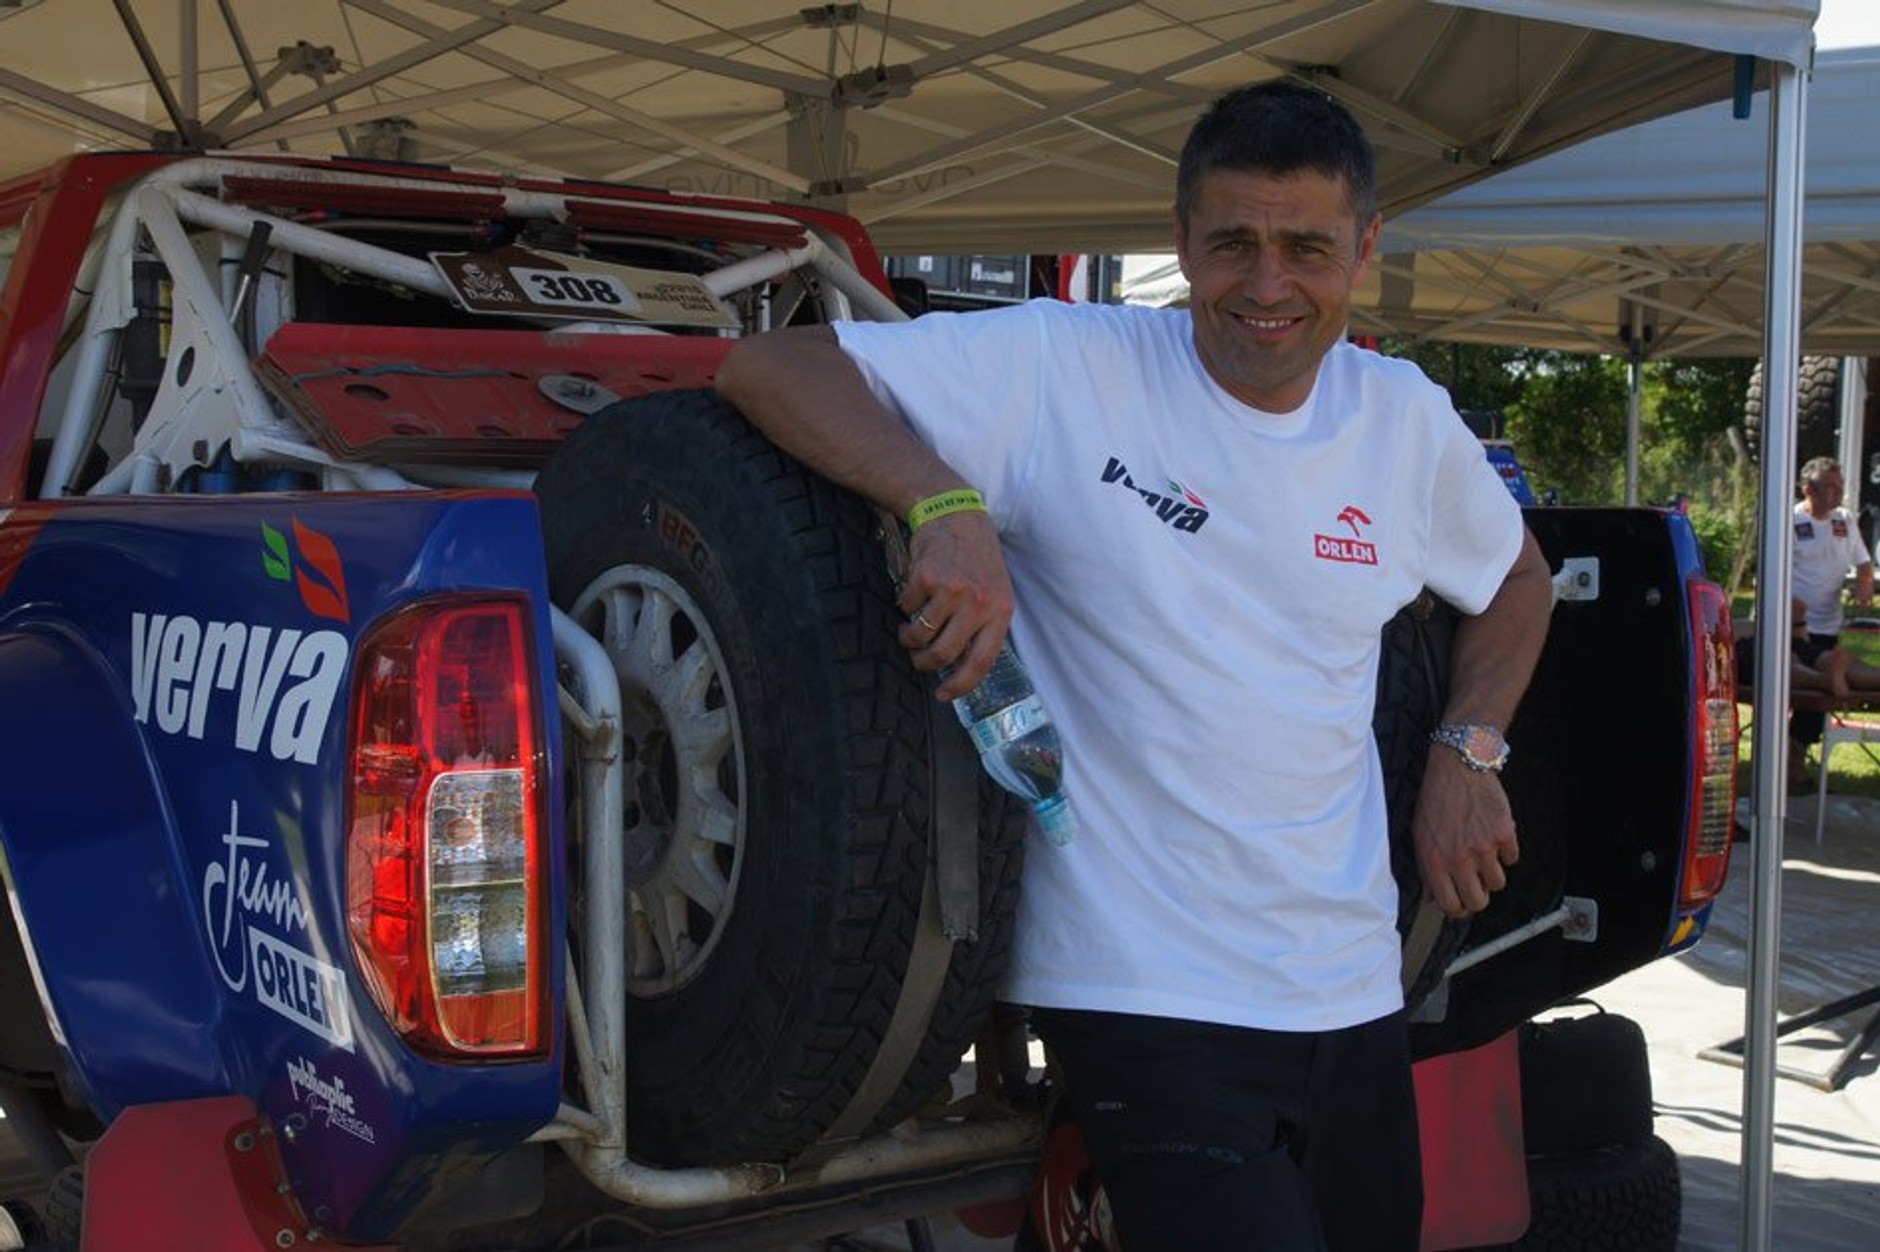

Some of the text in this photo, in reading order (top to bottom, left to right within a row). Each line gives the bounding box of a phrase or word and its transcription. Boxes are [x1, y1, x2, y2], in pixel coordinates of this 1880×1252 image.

[531, 274, 622, 305] 308
[1318, 537, 1375, 563] ORLEN
[131, 611, 350, 766] verva
